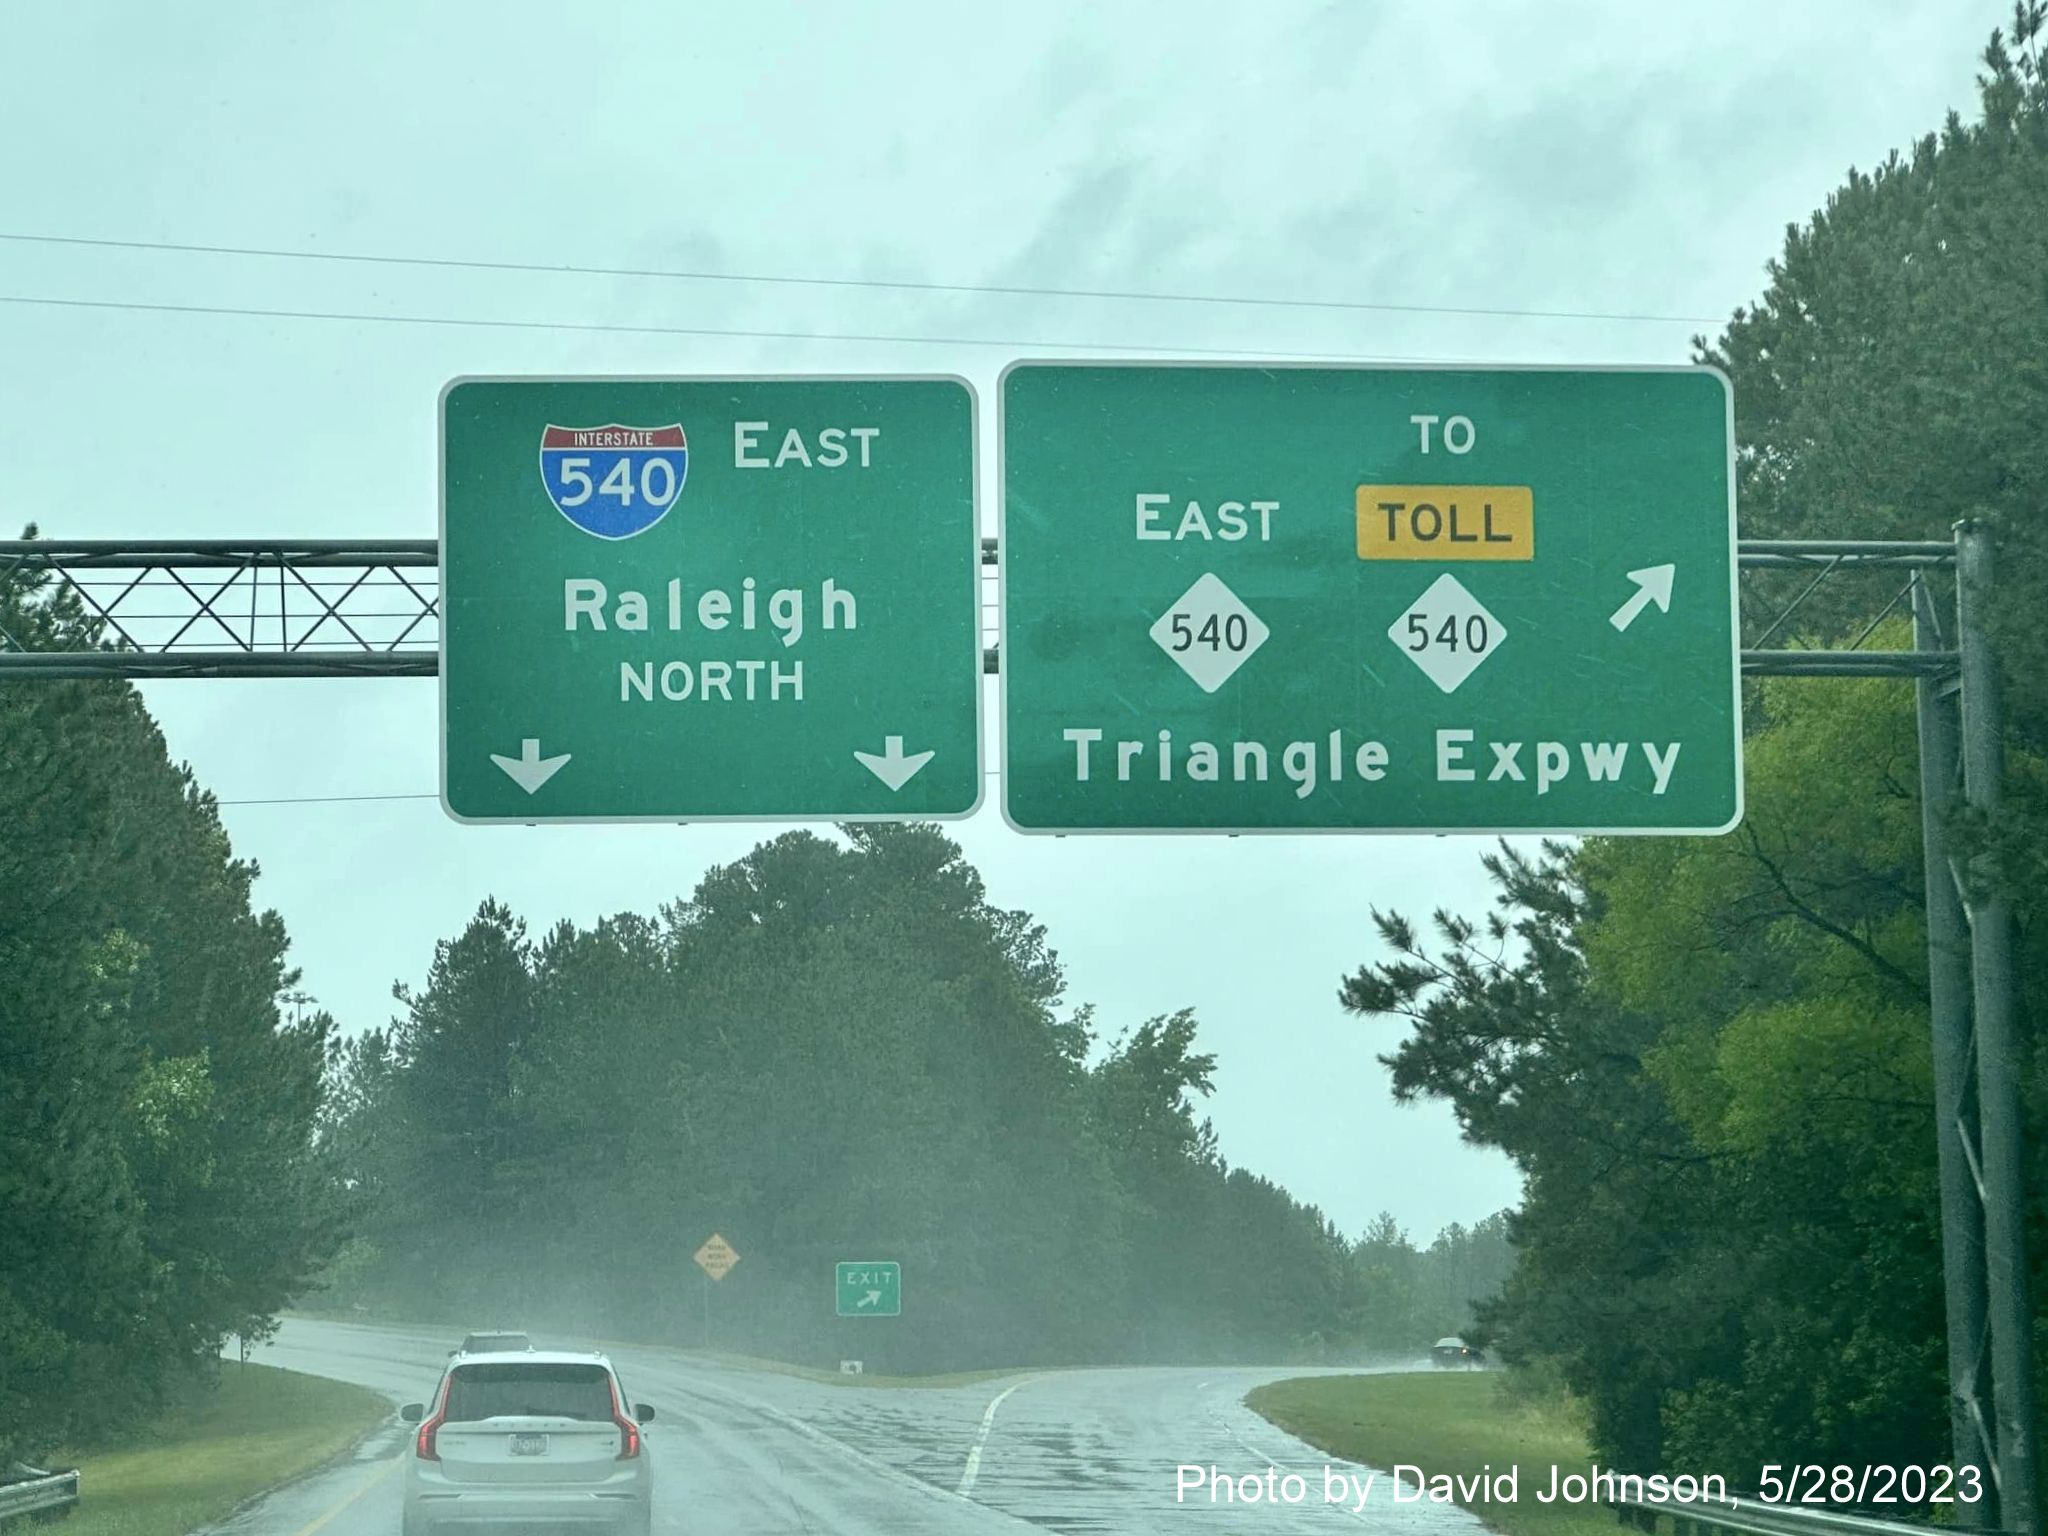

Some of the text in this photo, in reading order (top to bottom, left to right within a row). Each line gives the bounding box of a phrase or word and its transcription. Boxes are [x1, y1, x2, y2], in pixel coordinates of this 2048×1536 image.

[574, 431, 654, 447] INTERSTATE
[735, 421, 880, 468] EAST
[1411, 415, 1476, 455] TO
[559, 457, 675, 507] 540
[1136, 493, 1280, 542] EAST
[1378, 502, 1513, 543] TOLL
[564, 577, 857, 647] Raleigh
[1170, 613, 1248, 653] 540
[1408, 614, 1488, 653] 540
[620, 661, 804, 702] NORTH
[1063, 728, 1681, 799] Triangle Expwy
[847, 1272, 892, 1285] EXIT
